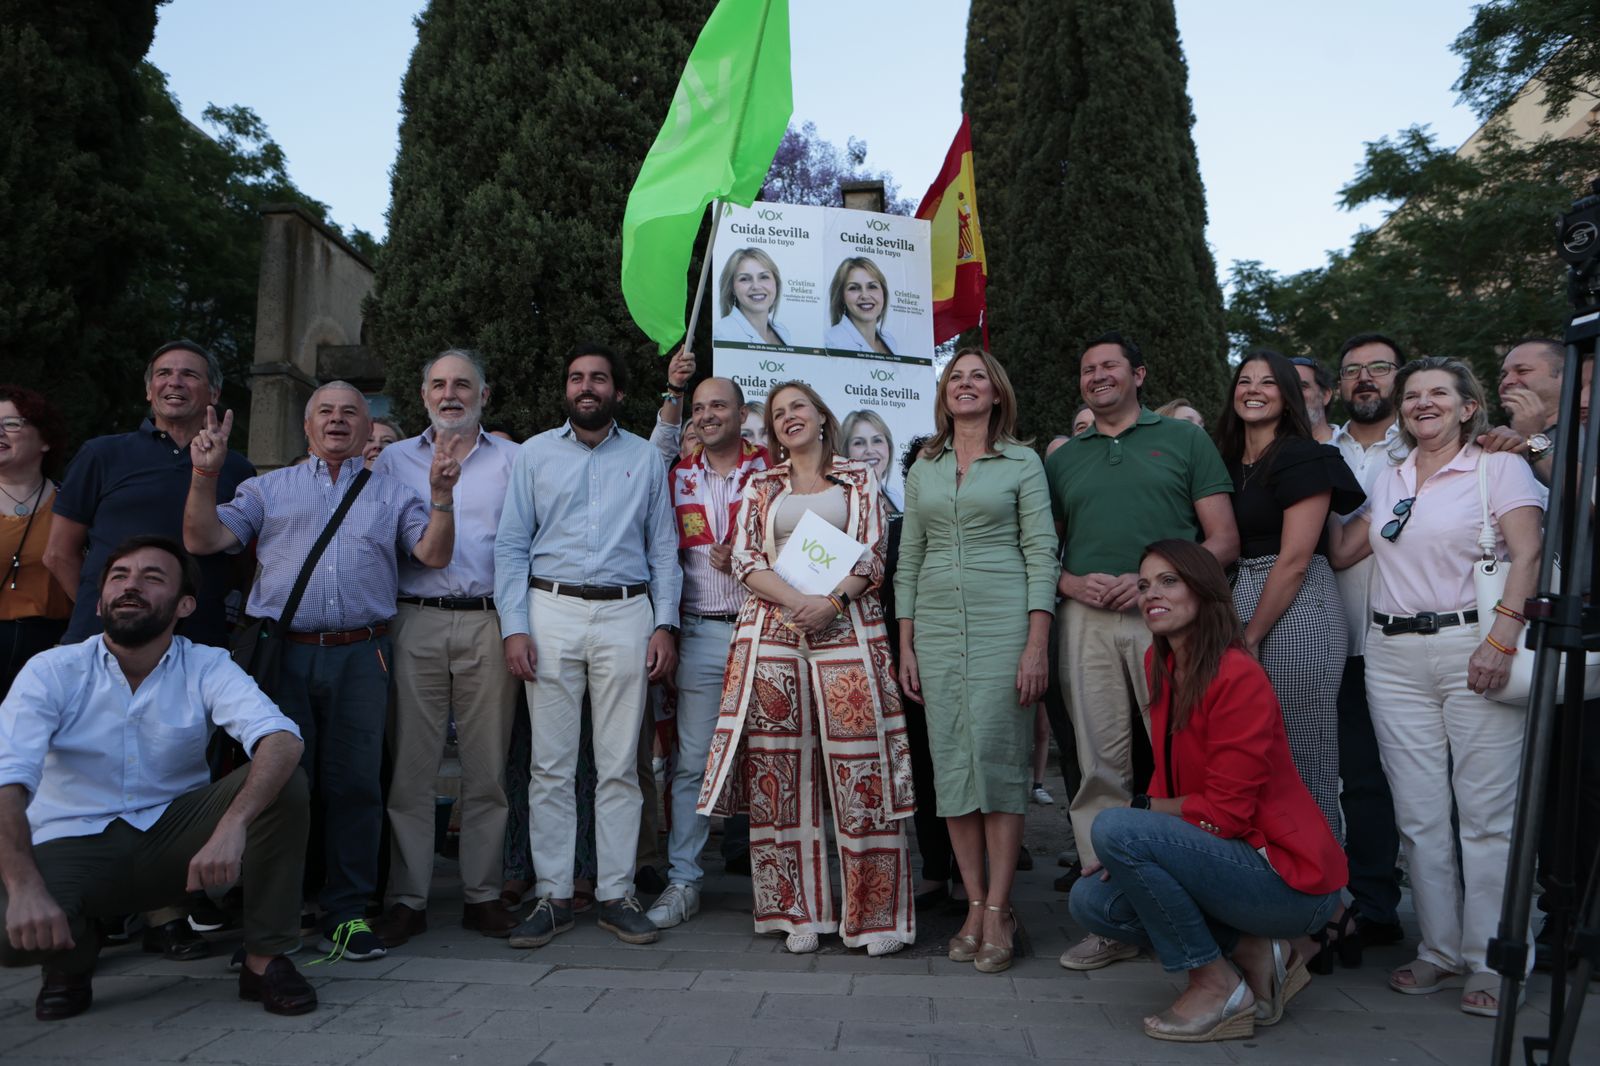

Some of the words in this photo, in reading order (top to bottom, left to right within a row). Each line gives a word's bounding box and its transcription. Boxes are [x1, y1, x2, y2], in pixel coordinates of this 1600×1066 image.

[757, 208, 783, 221] VOX
[730, 223, 765, 236] Cuida
[768, 225, 810, 240] Sevilla
[866, 218, 890, 232] VOX
[746, 236, 767, 245] cuida
[768, 237, 776, 245] lo
[776, 238, 795, 247] tuyo
[840, 232, 873, 246] Cuida
[876, 235, 915, 252] Sevilla
[855, 245, 875, 255] cuida
[876, 247, 884, 255] lo
[884, 248, 901, 258] tuyo
[787, 279, 816, 288] Cristina
[894, 290, 920, 300] Cristina
[759, 359, 785, 373] VOX
[870, 368, 895, 382] VOX
[747, 389, 769, 397] cuida
[844, 383, 878, 397] Cuida
[880, 387, 920, 401] Sevilla
[859, 397, 880, 406] cuida
[881, 399, 889, 407] lo
[889, 399, 906, 409] tuyo
[801, 537, 837, 570] VOX
